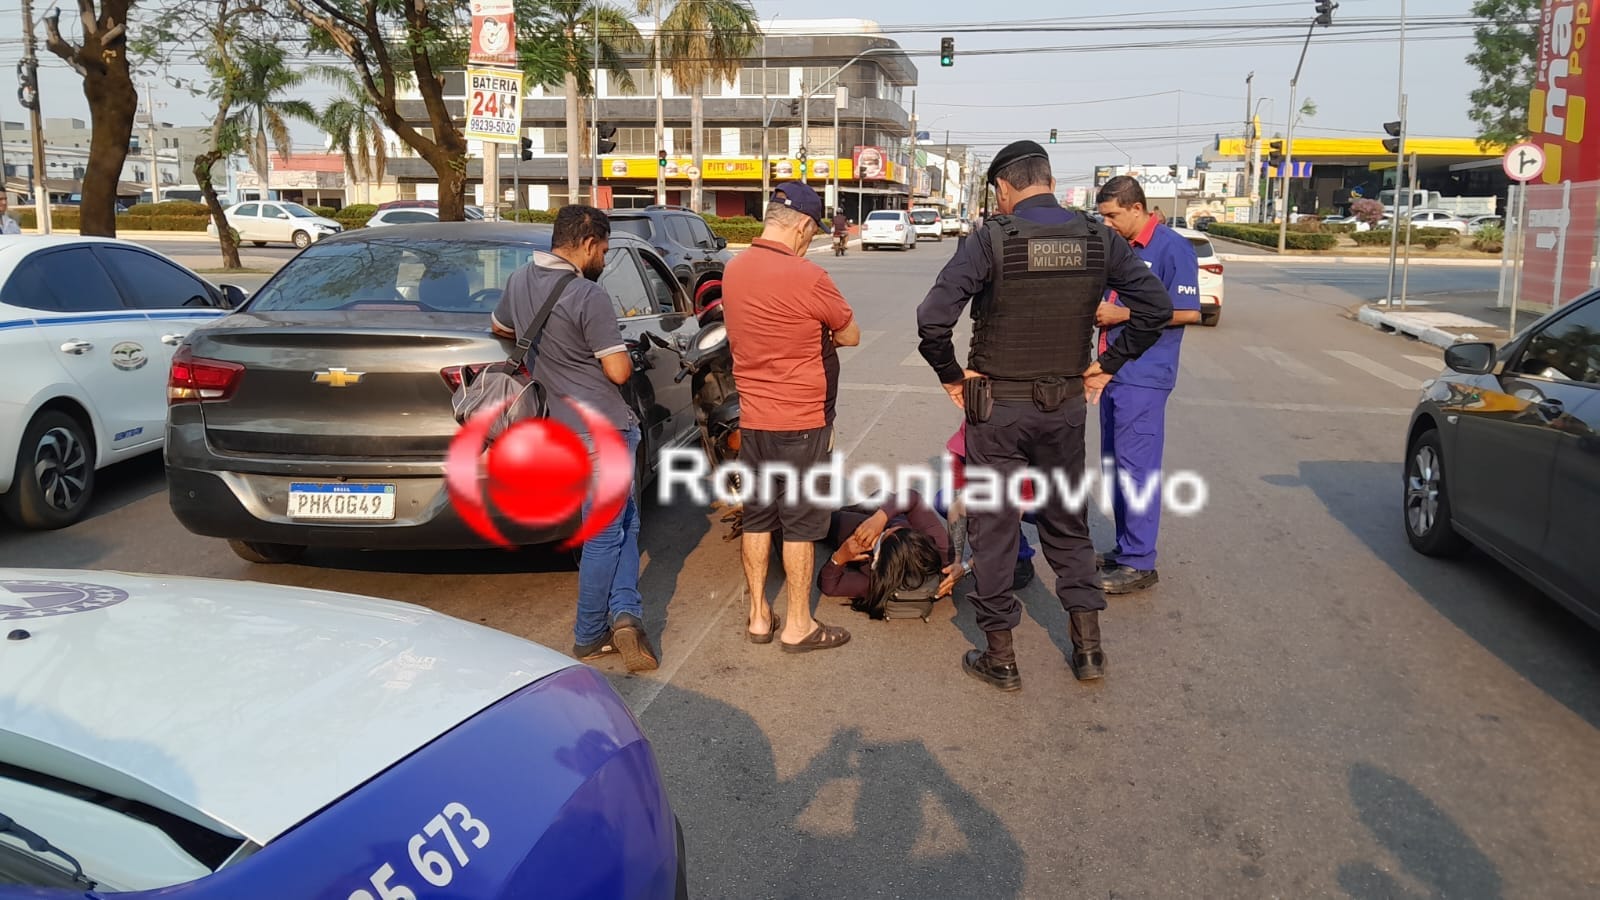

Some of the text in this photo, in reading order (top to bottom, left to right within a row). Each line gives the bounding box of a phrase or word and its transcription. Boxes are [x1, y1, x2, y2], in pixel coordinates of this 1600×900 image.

[1545, 0, 1574, 135] ma
[473, 76, 518, 92] BATERIA
[472, 91, 516, 119] 24H
[1033, 256, 1082, 267] MILITAR
[1177, 285, 1197, 295] PVH
[348, 802, 490, 900] 5 673
